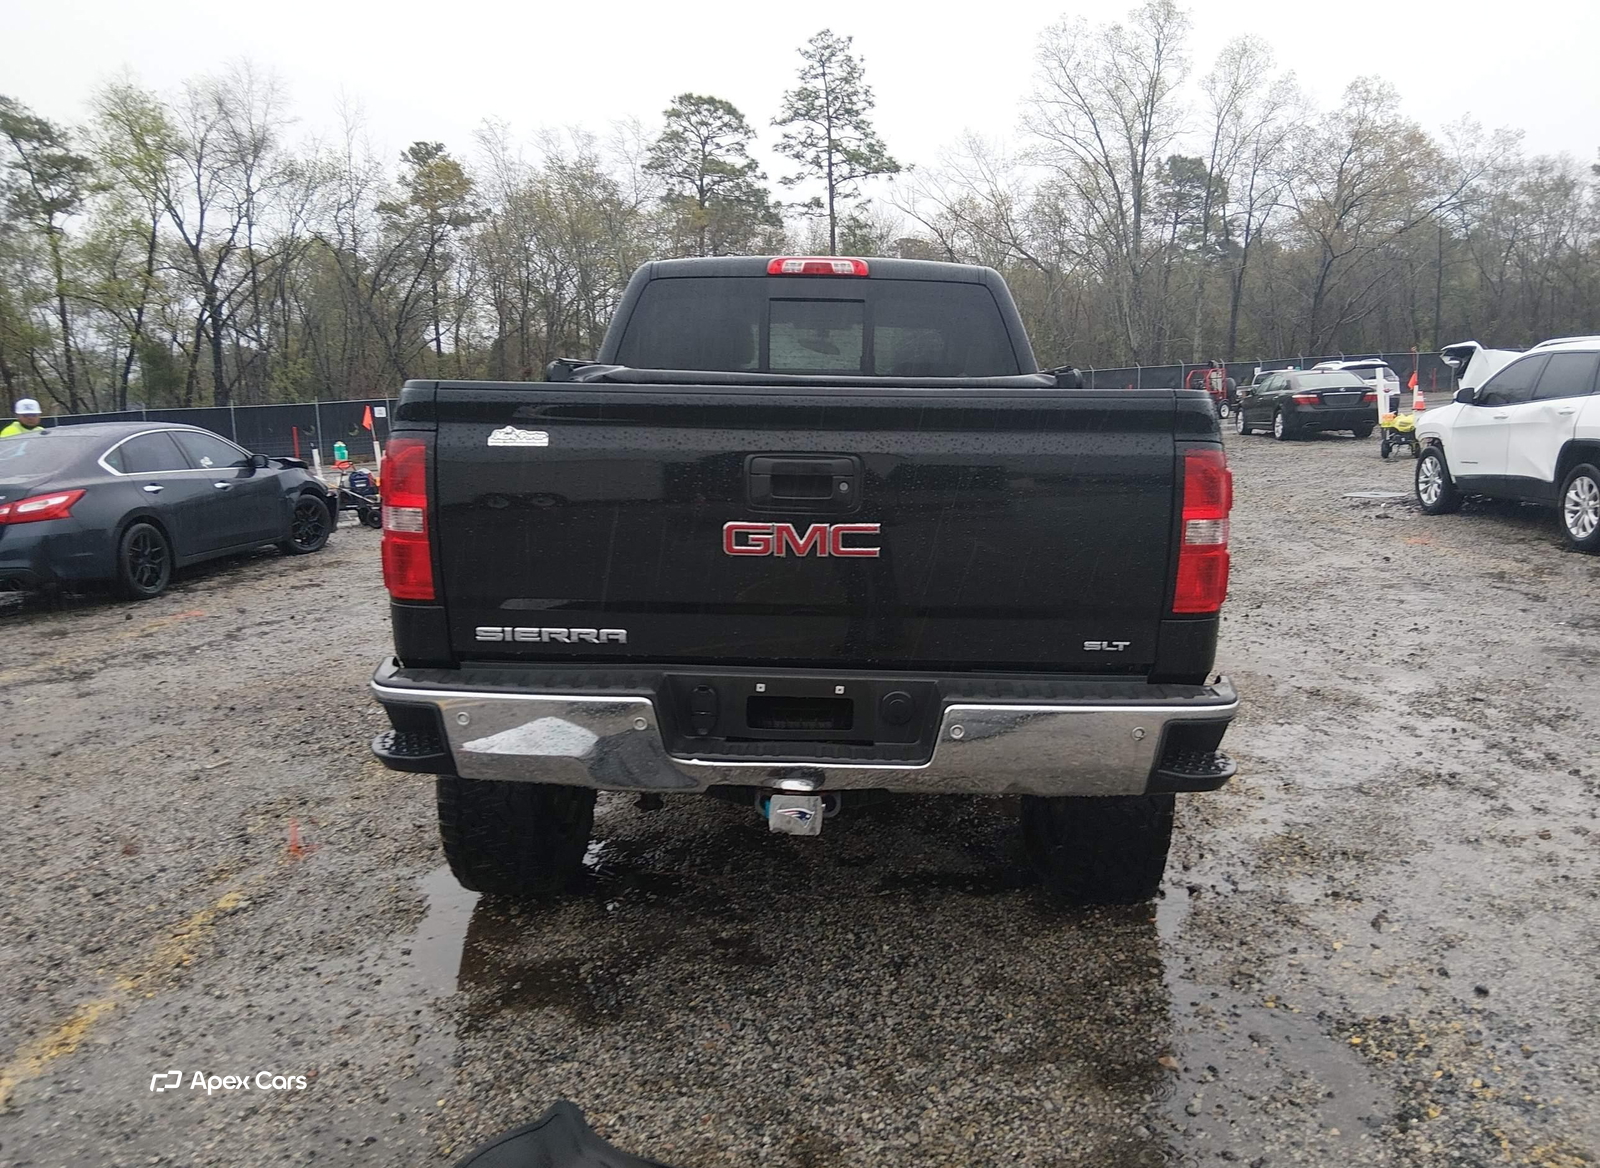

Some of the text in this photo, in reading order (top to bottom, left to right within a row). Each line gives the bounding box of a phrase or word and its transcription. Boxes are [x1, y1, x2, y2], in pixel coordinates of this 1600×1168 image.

[723, 521, 881, 557] GMC
[475, 626, 628, 644] SIERRA
[1083, 641, 1131, 651] SLT
